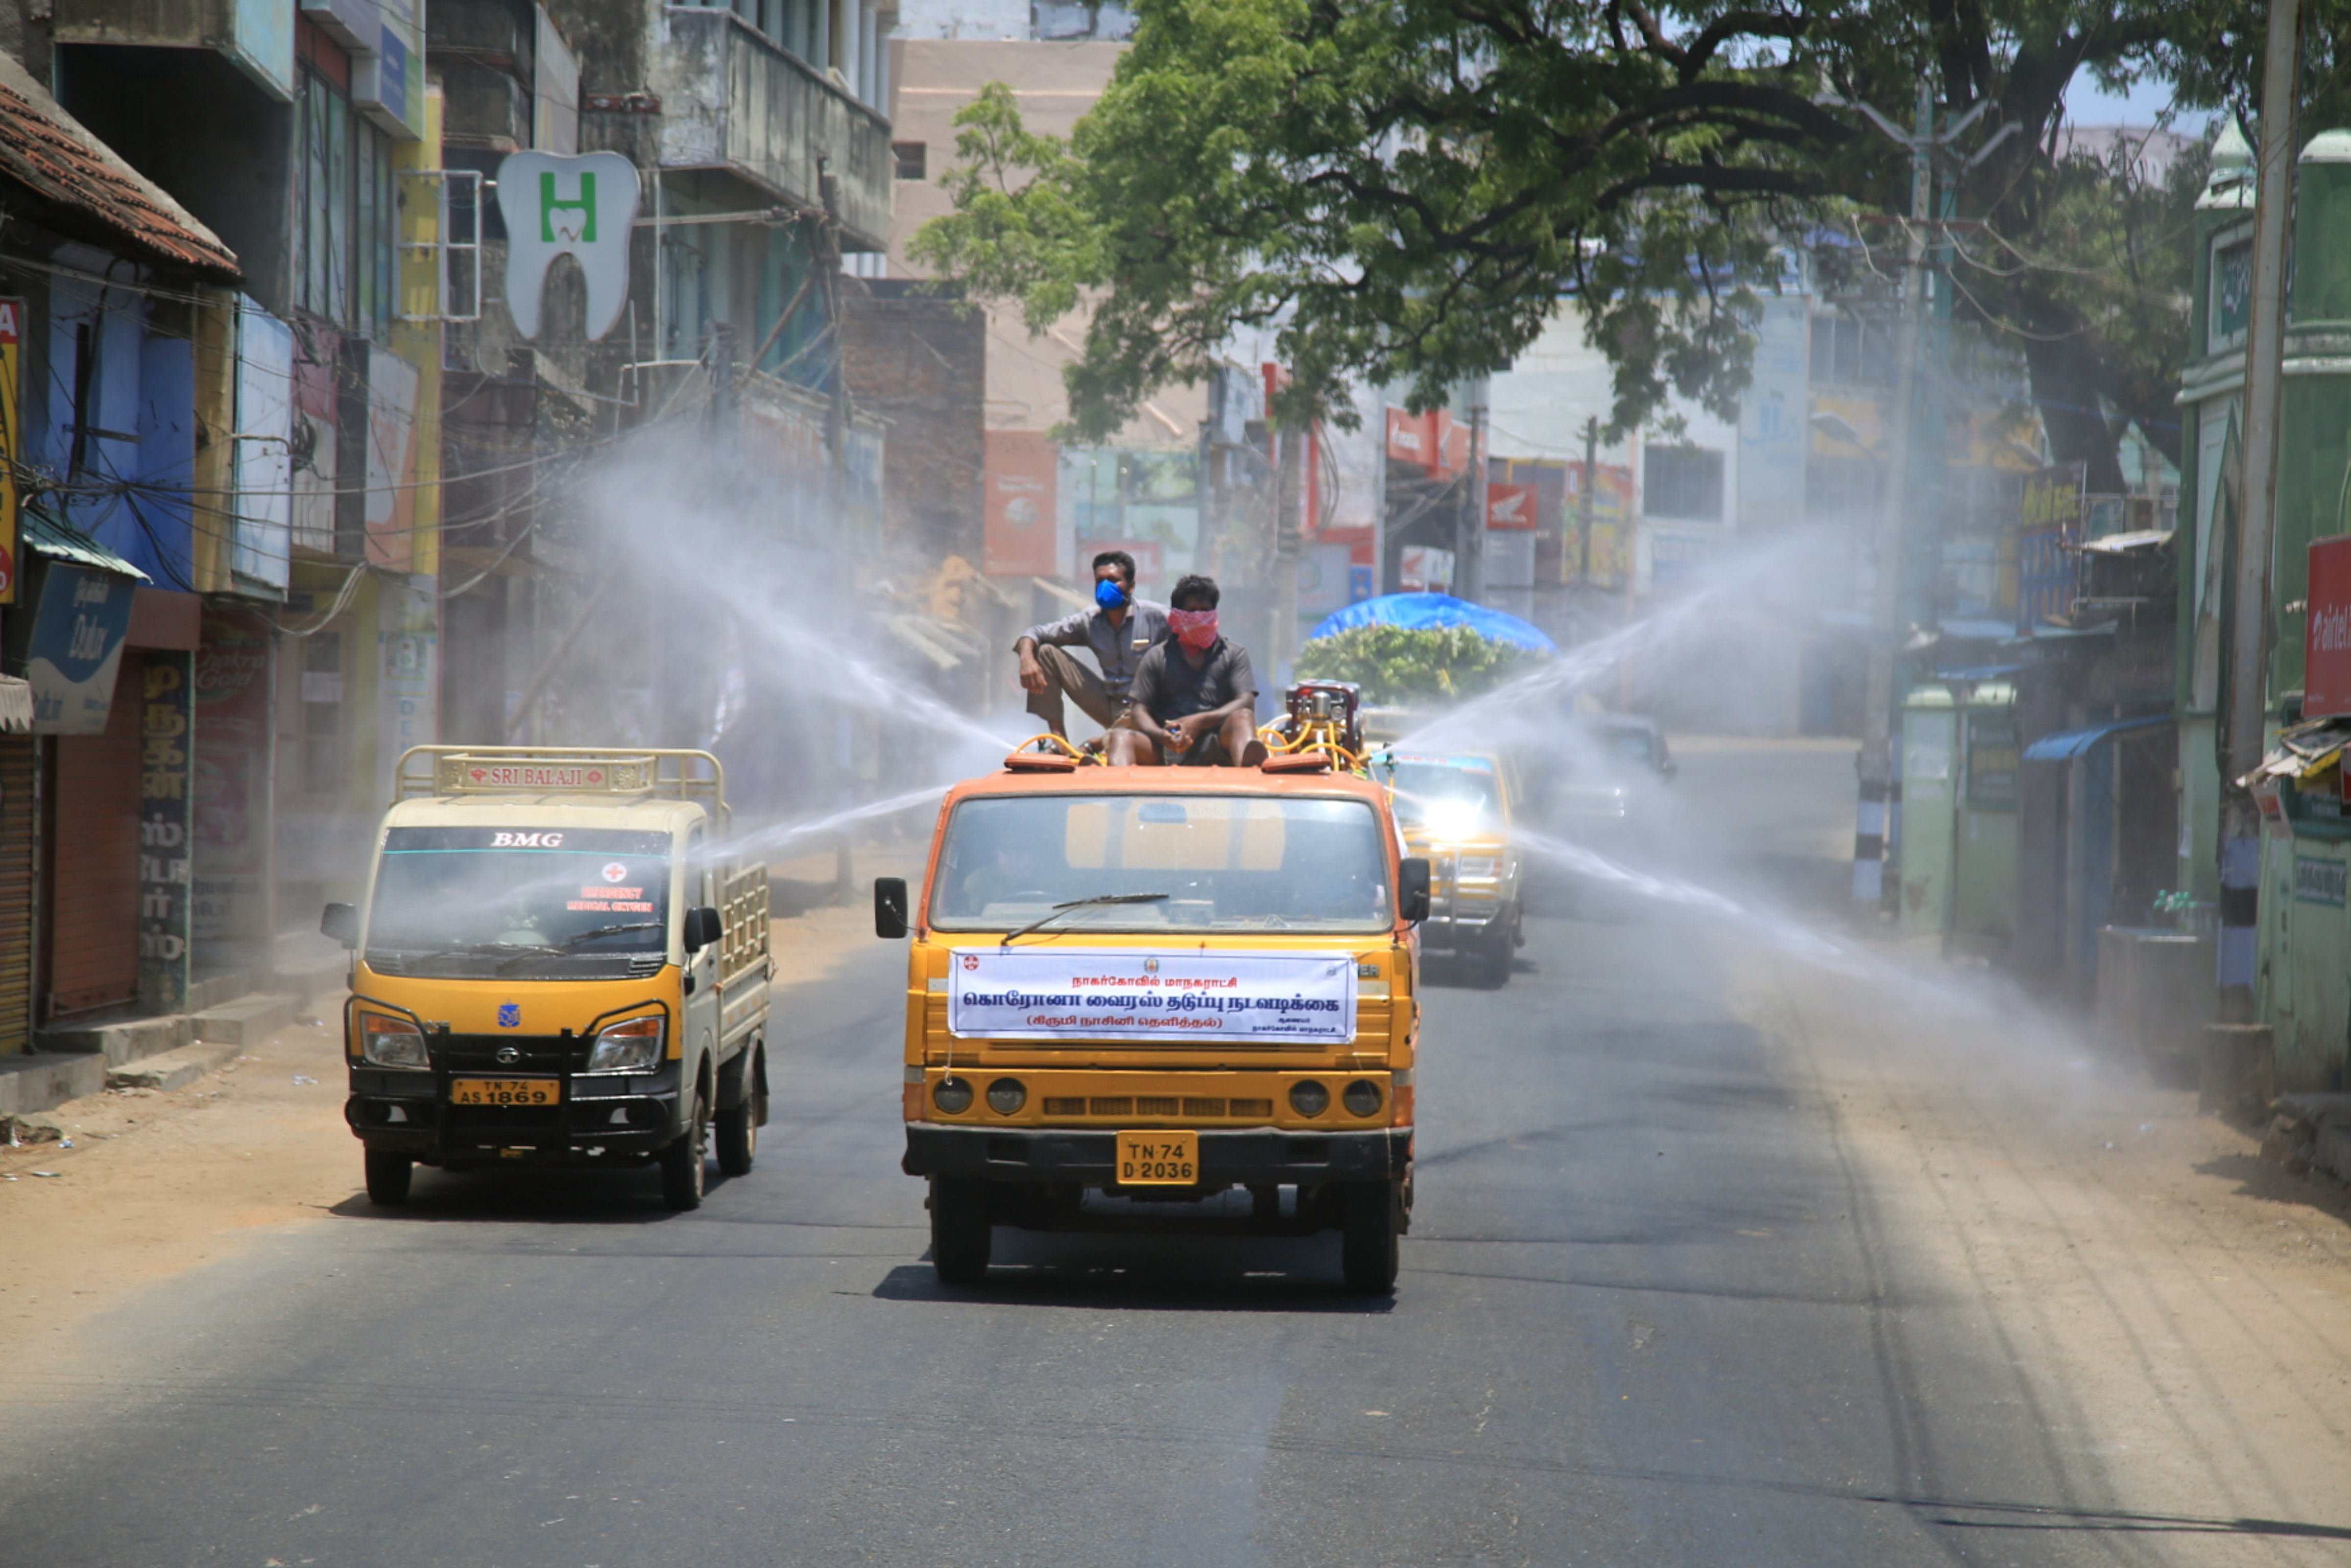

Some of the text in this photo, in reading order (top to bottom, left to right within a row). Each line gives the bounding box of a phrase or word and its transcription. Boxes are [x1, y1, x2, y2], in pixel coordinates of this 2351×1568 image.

[2323, 603, 2348, 652] airtel
[69, 613, 108, 660] Dulux
[491, 768, 582, 784] SRI BALAJI
[491, 832, 564, 847] BMG
[581, 886, 644, 899] EMERGENCY
[567, 901, 654, 912] MEDICAL OXYGEN
[1071, 975, 1237, 990] நாகர்கோவில் மாநகராட்சி
[963, 990, 1340, 1014] கொரோனா வைரஸ் தடுப்பு நடவடிக்கை
[1027, 1015, 1223, 1029] (கிருமி நாசினி தெளித்தல்)
[484, 1081, 528, 1091] TN 74
[461, 1092, 547, 1104] AS 1869
